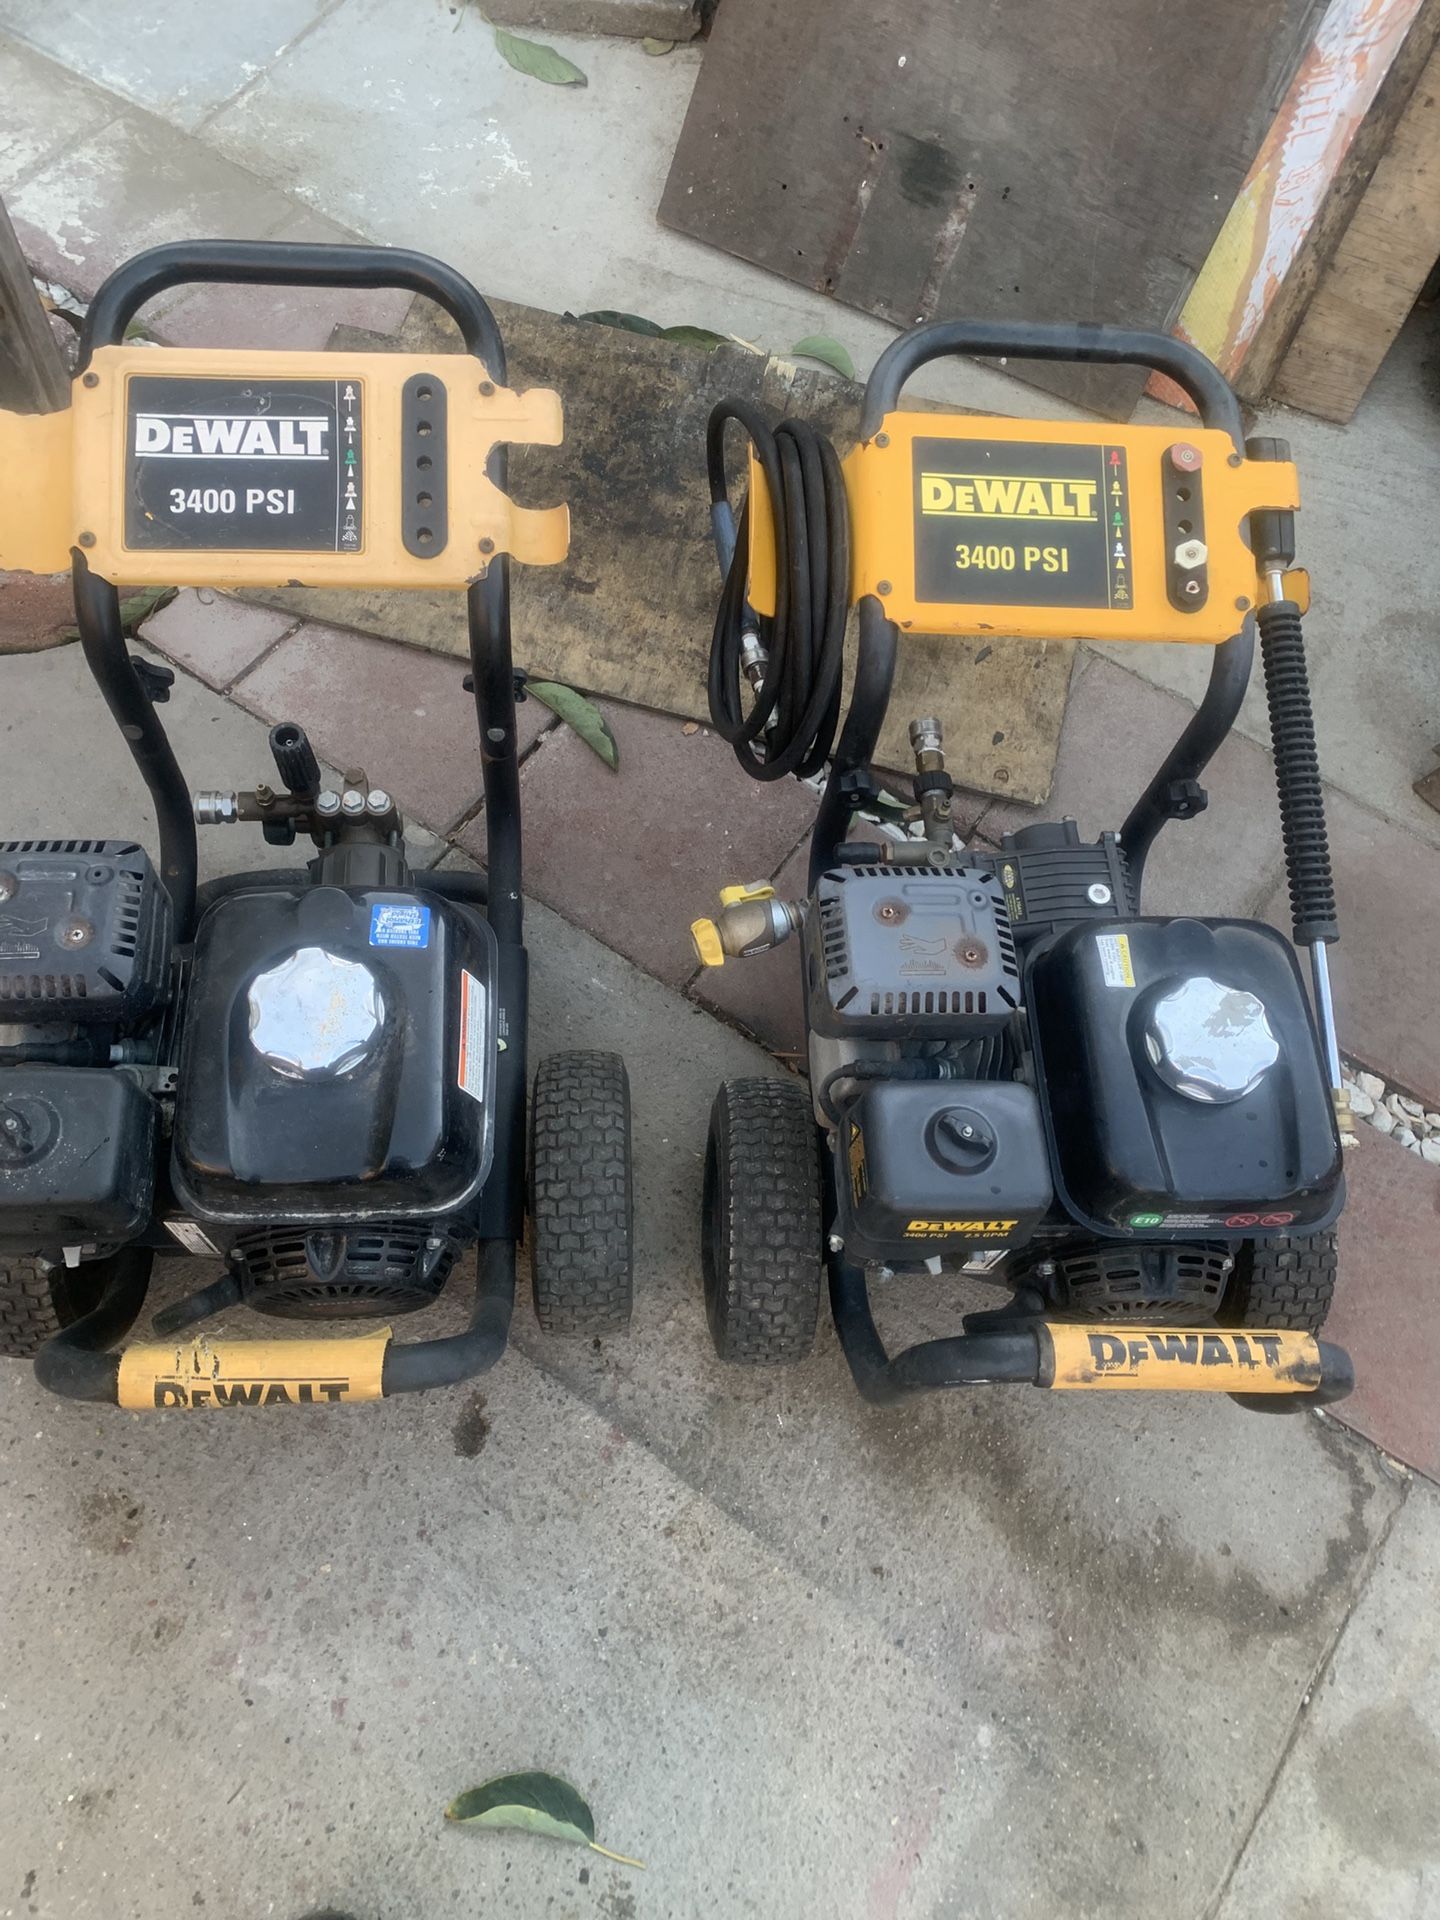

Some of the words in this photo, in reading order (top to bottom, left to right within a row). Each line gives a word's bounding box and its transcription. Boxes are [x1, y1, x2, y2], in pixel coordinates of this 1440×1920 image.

[169, 488, 236, 514] 3400
[246, 489, 295, 515] PSI
[955, 544, 1015, 571] 3400
[1024, 546, 1069, 573] PSI
[1134, 1217, 1160, 1225] E10
